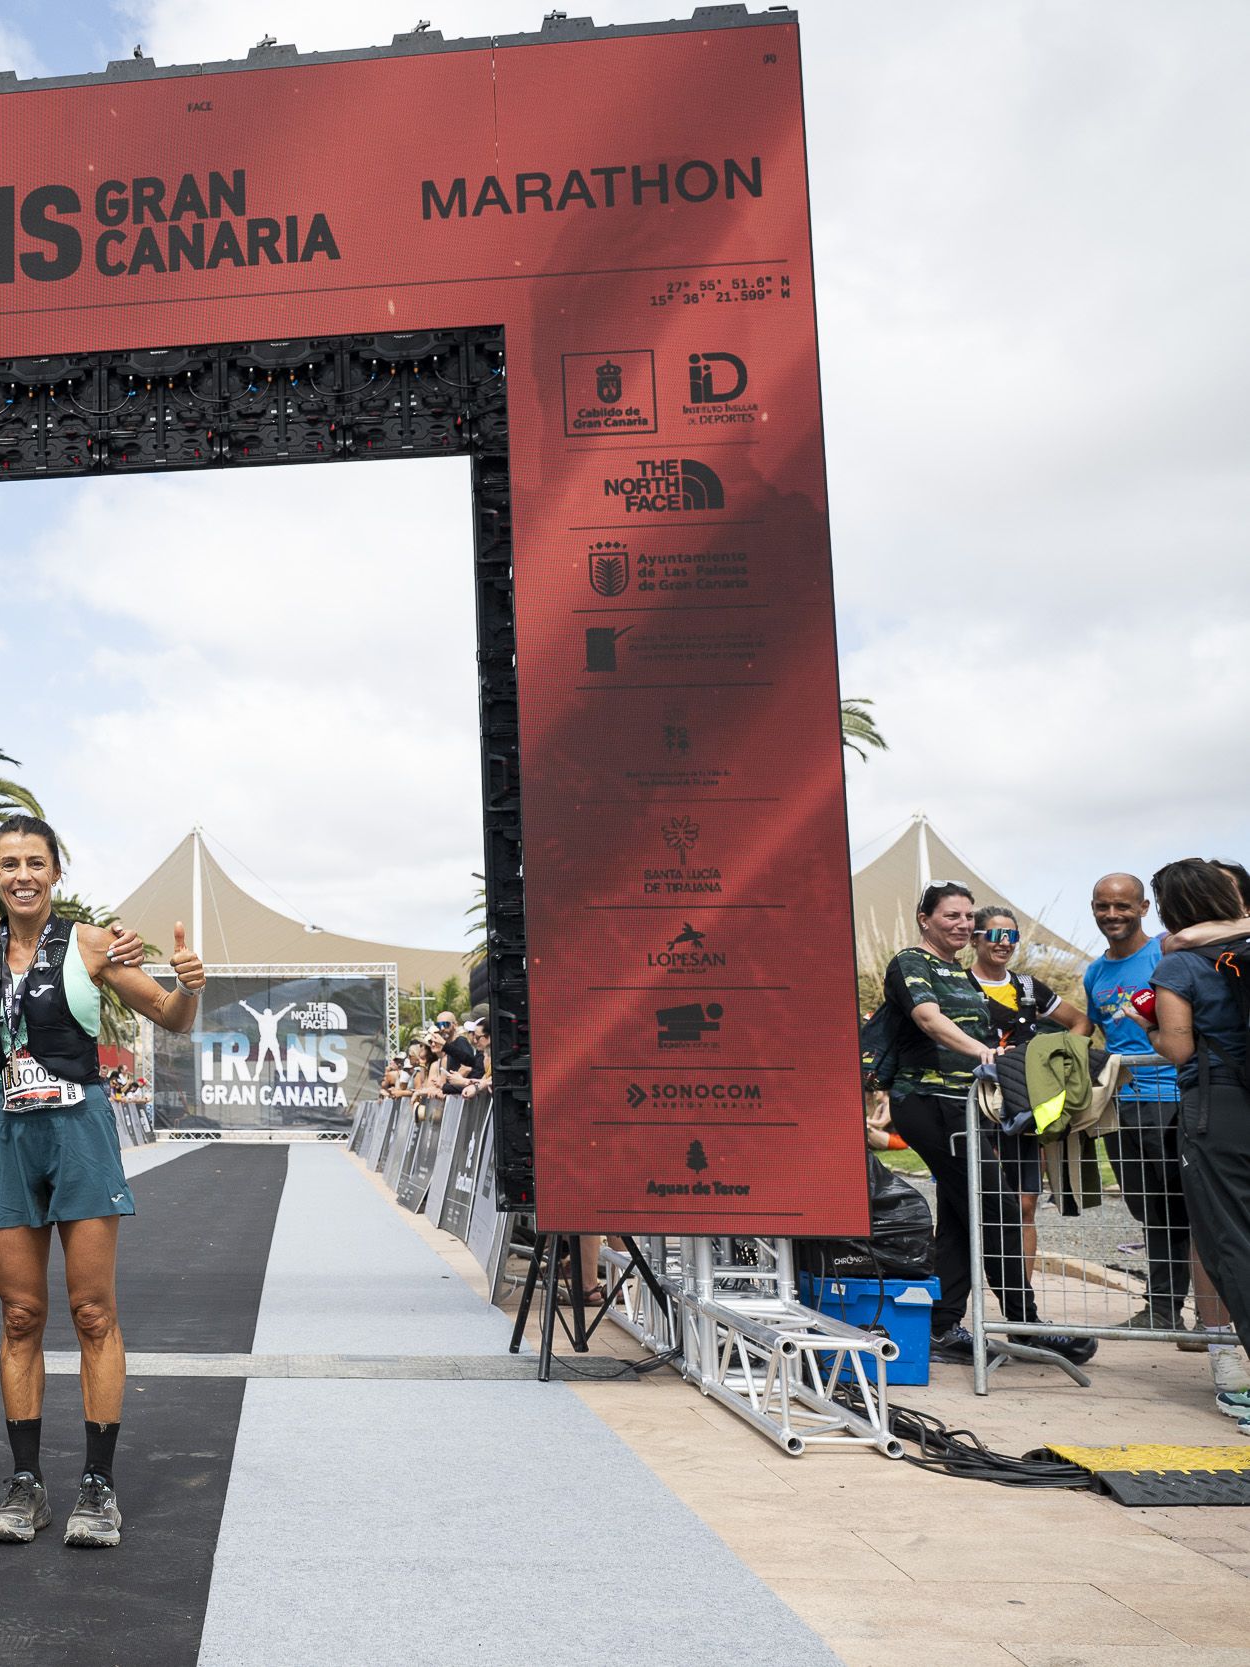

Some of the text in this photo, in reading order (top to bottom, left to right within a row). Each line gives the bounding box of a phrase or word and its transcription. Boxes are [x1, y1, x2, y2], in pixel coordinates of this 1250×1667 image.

[187, 101, 213, 112] FACE
[421, 156, 764, 221] MARATHON
[95, 169, 246, 227] GRAN
[95, 213, 342, 277] CANARIA
[781, 275, 791, 287] N
[781, 288, 791, 299] W
[576, 406, 640, 419] Cabildo de
[699, 413, 755, 425] DEPORTES
[573, 416, 648, 430] Gran Canaria
[636, 459, 679, 477] THE
[604, 476, 680, 496] NORTH
[625, 493, 681, 513] FACE
[636, 552, 748, 567] Ayuntamiento
[643, 868, 683, 880] SANTA
[644, 882, 722, 894] DE TIRAJANA
[647, 952, 726, 967] LOPESAN
[306, 1002, 327, 1011] THE
[291, 1011, 327, 1021] NORTH
[300, 1019, 328, 1029] FACE
[201, 1084, 348, 1107] GRAN CANARIA
[651, 1084, 762, 1100] SONOCOM
[646, 1180, 750, 1197] Aguas de Teror
